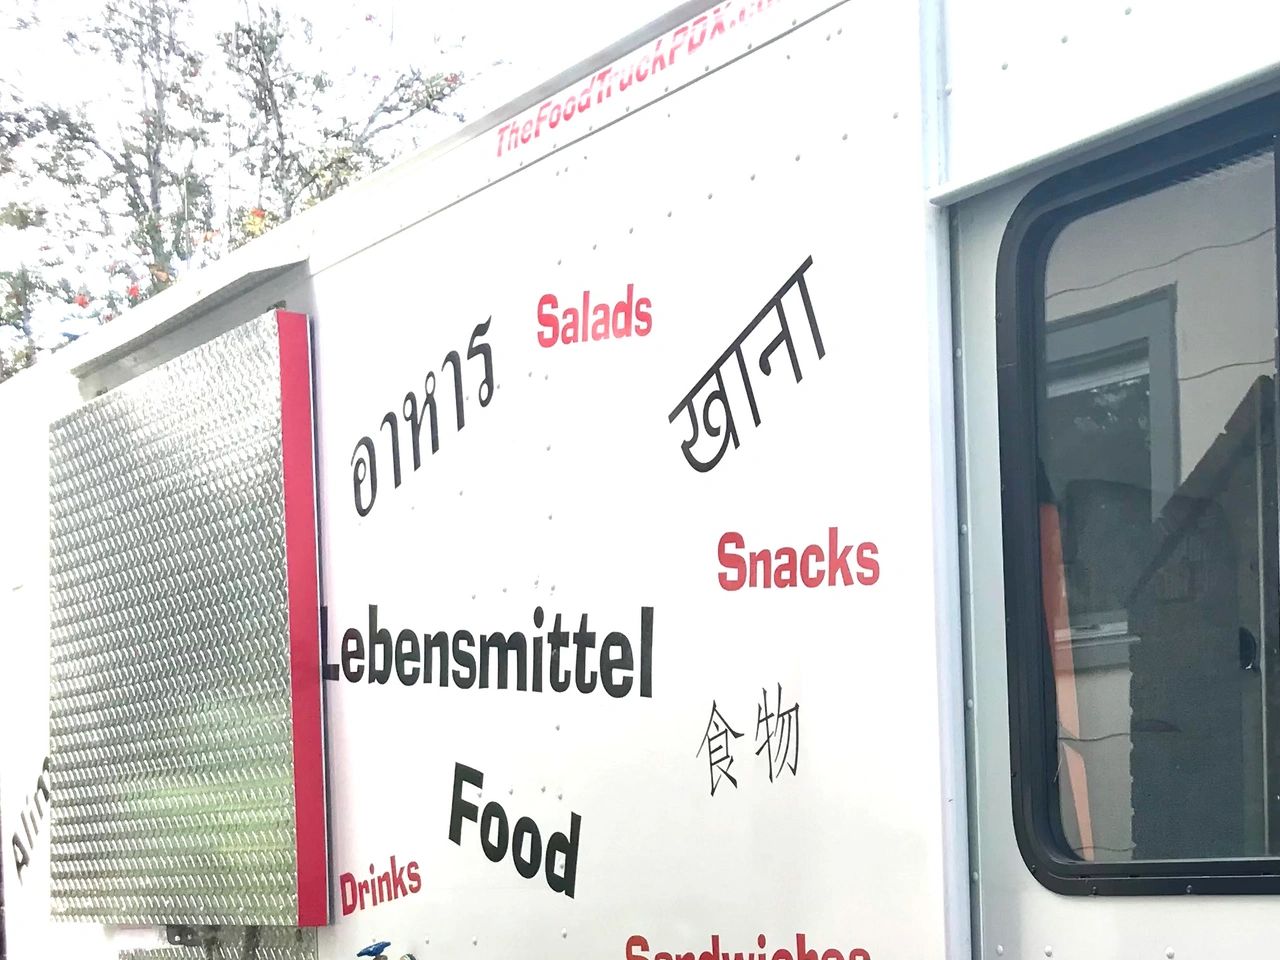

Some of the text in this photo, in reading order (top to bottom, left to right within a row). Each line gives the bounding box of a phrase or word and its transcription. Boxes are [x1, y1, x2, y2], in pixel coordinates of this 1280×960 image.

[537, 283, 653, 349] Salads
[668, 254, 826, 473] खाना
[351, 315, 494, 517] อาหาร
[718, 527, 880, 592] Snacks
[320, 603, 654, 698] Lebensmittel
[696, 682, 800, 797] 食物
[448, 761, 582, 900] Food
[339, 856, 421, 917] Drinks
